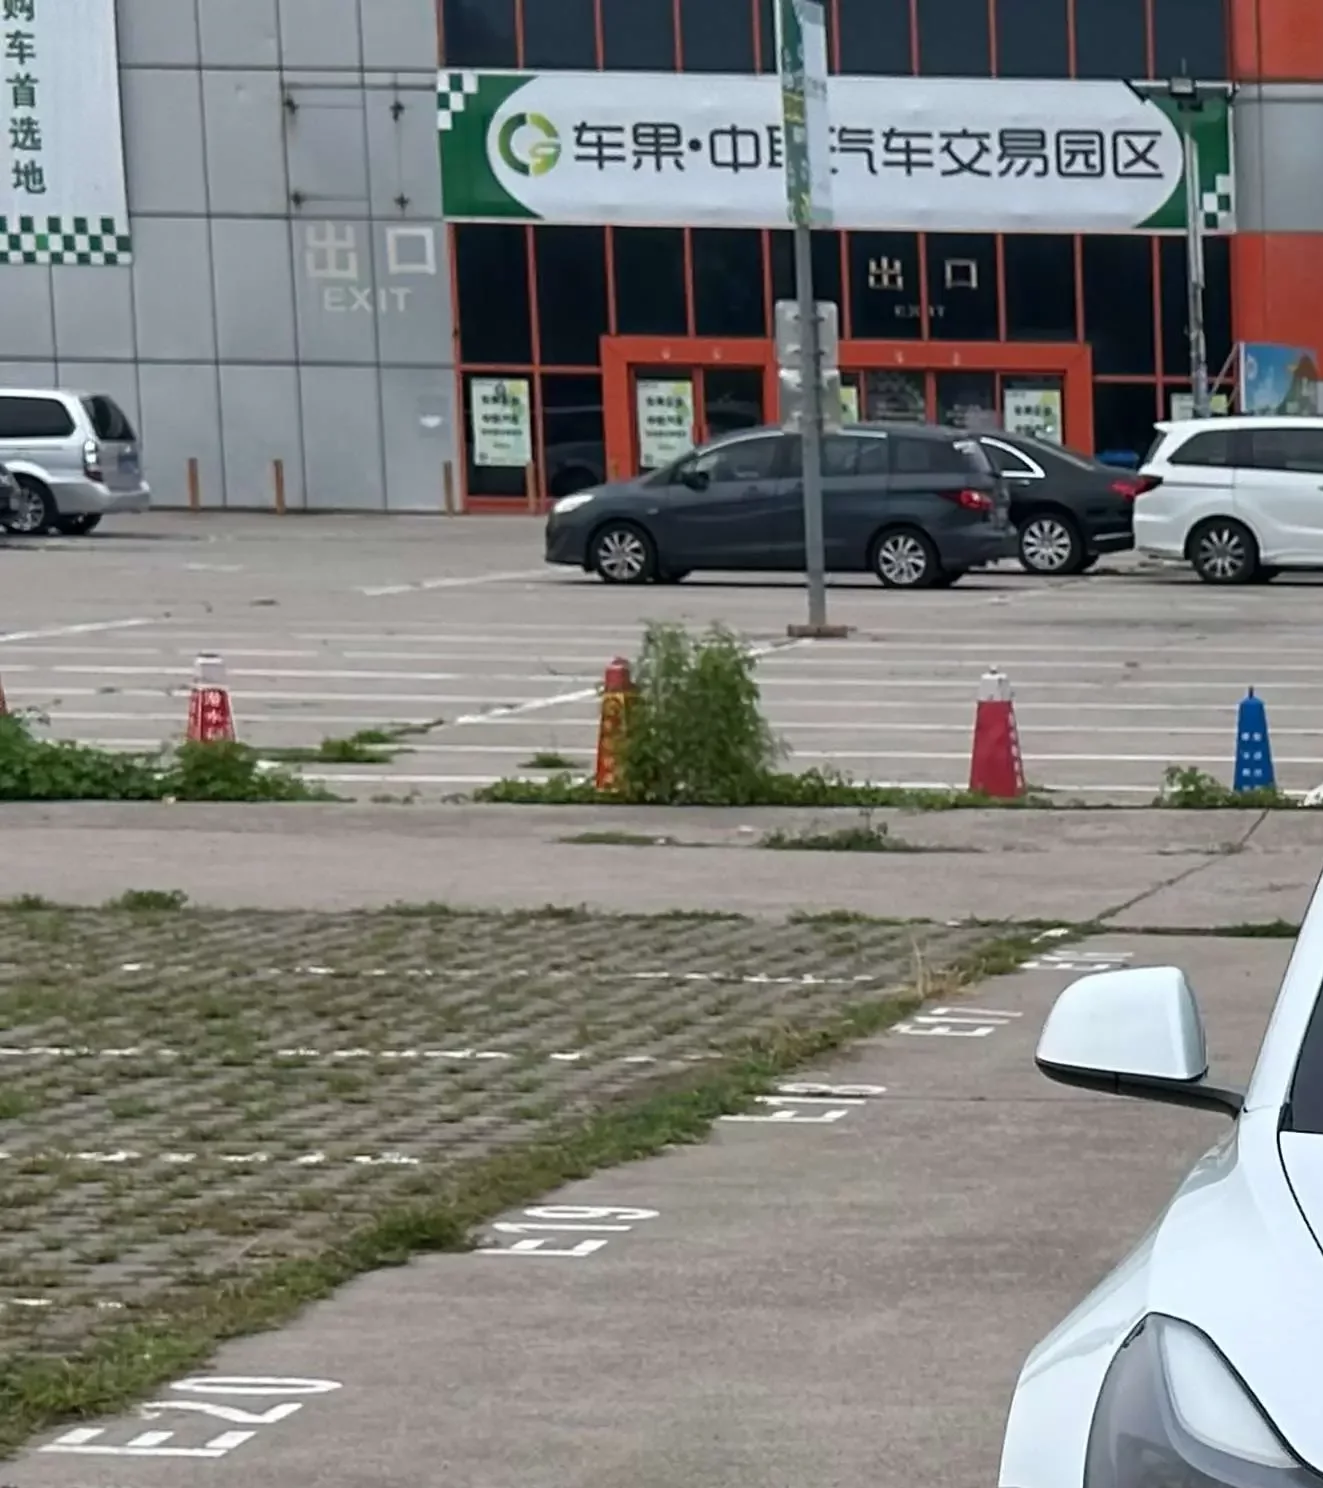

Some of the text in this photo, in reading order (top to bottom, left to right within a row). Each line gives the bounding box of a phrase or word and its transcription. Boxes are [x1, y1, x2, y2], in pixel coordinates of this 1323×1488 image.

[3, 0, 47, 195] 购车首选地
[305, 220, 437, 281] 出口
[868, 255, 979, 292] 出口
[323, 286, 413, 313] EXIT
[473, 1205, 661, 1257] E19
[39, 1376, 343, 1458] E20
